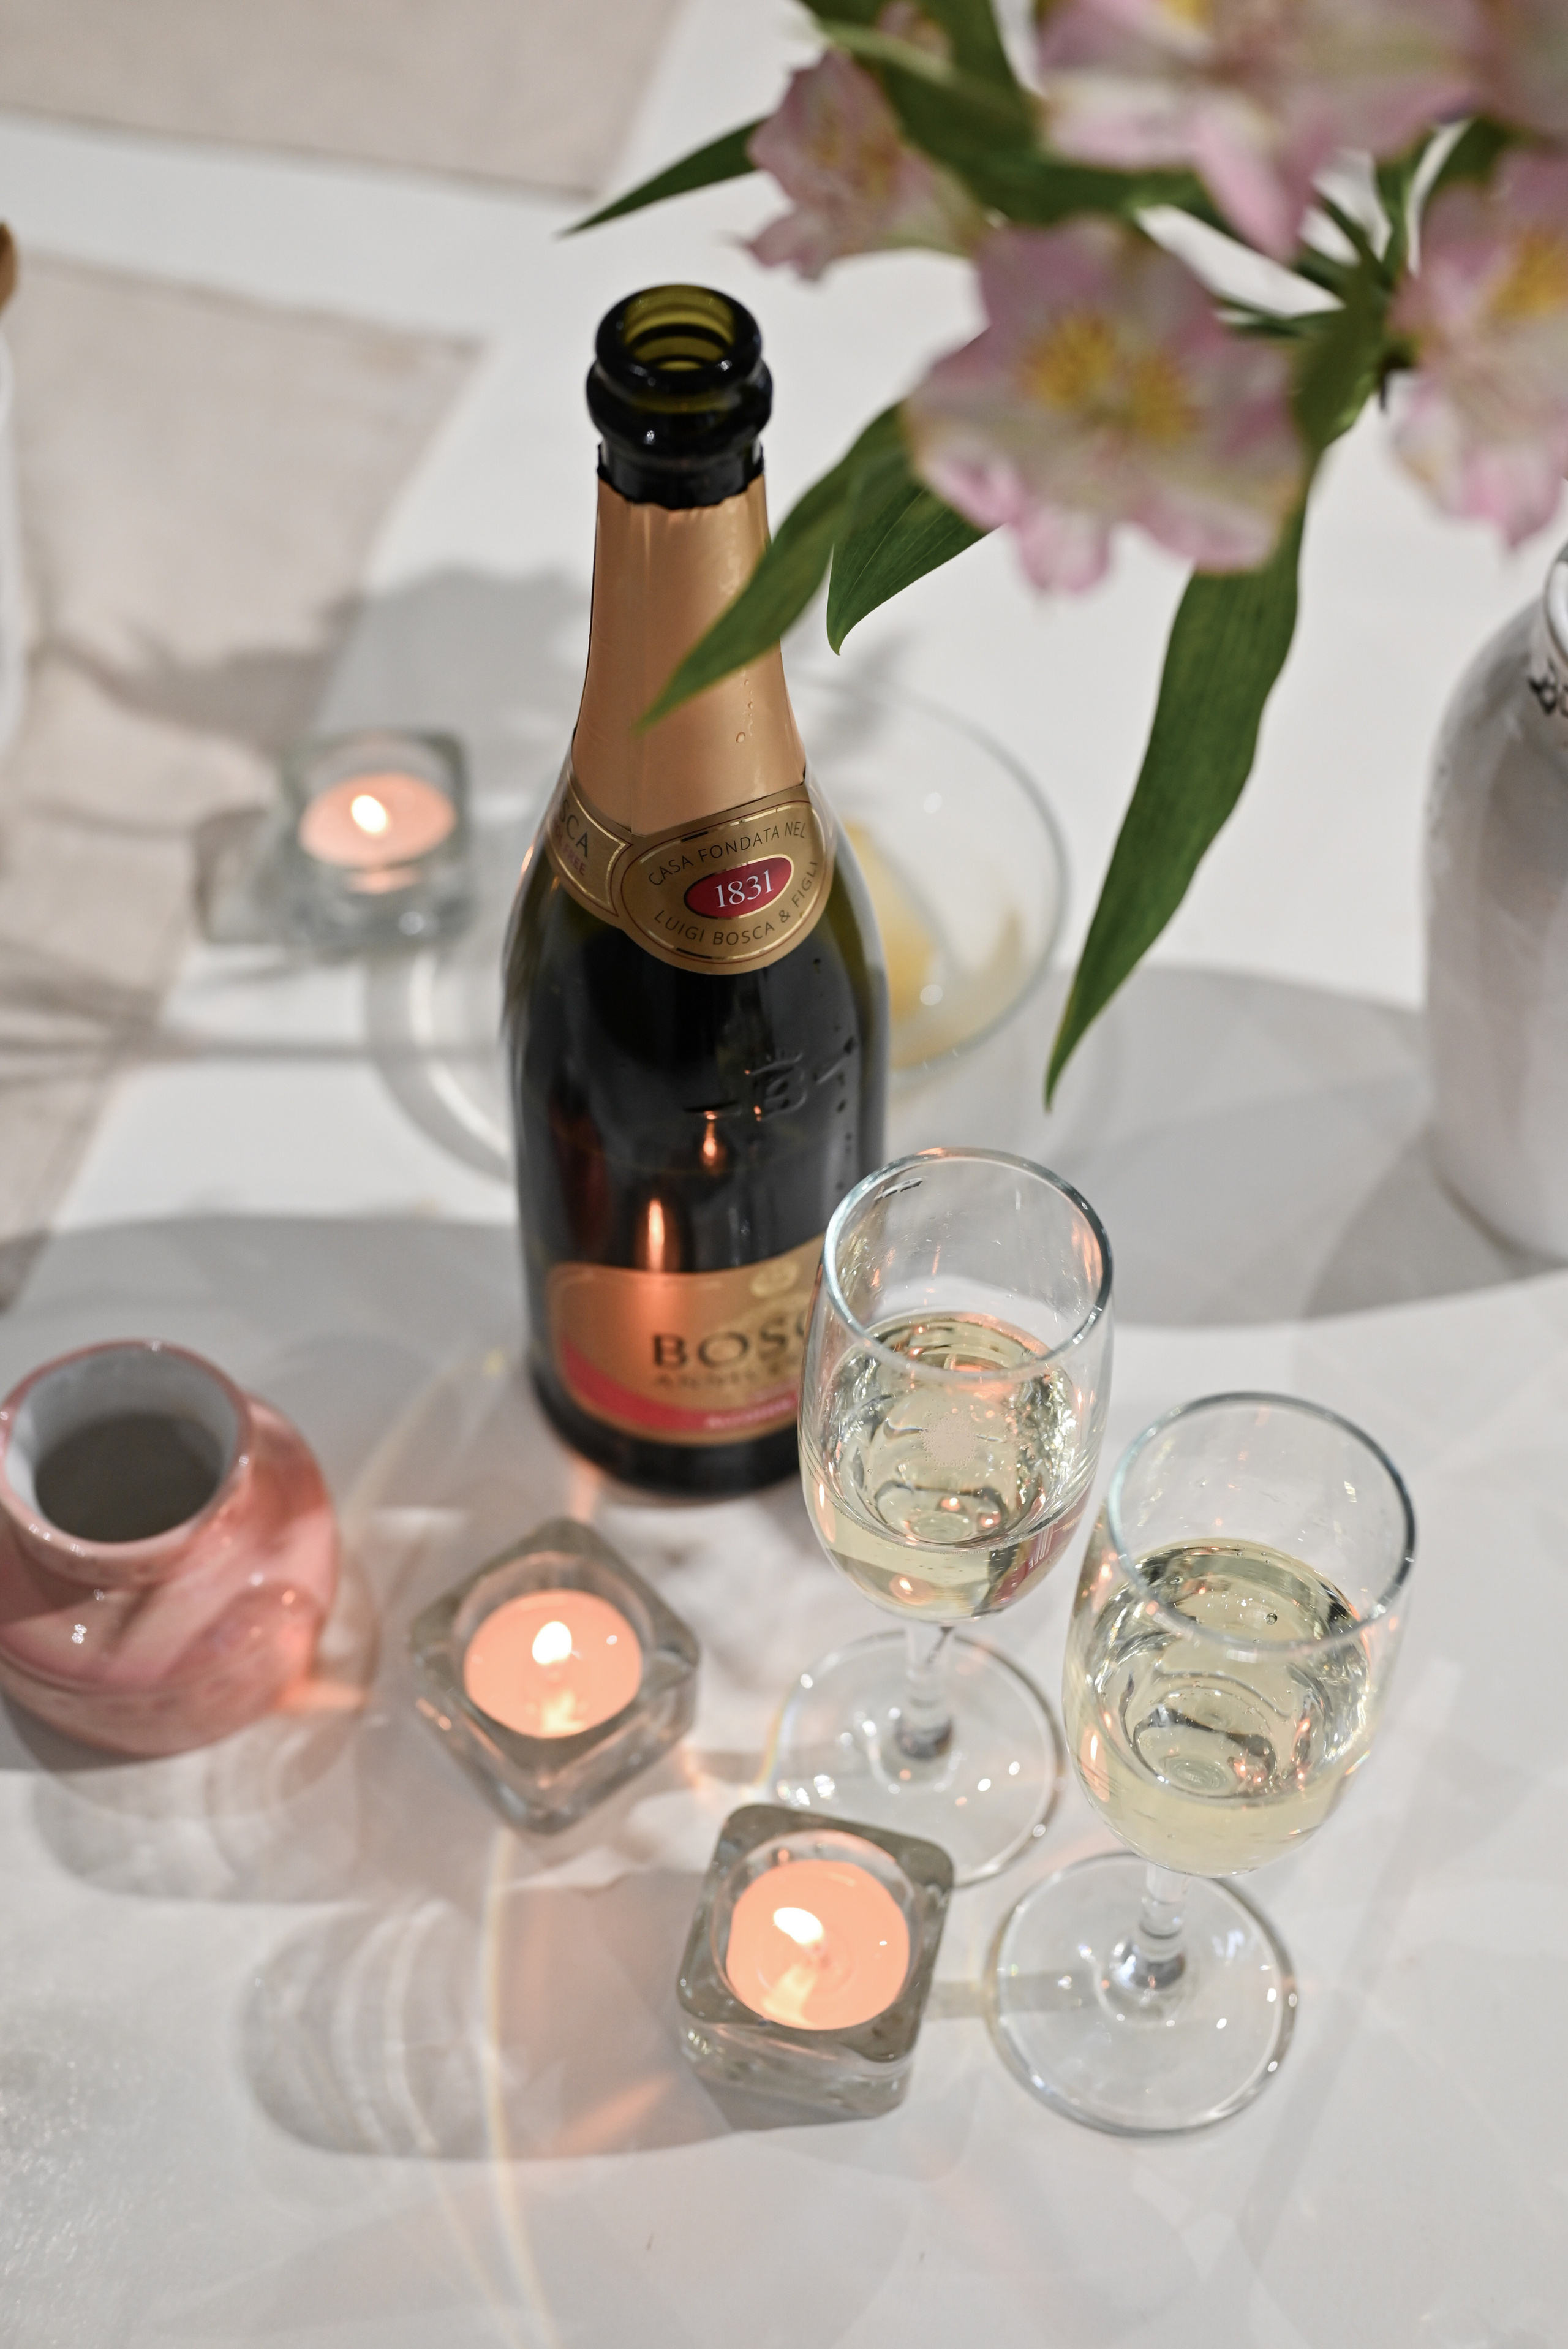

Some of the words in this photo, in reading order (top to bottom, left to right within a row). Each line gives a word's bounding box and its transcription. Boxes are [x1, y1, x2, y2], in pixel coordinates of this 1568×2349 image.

[563, 843, 586, 876] FREE
[649, 855, 693, 885] CASA
[698, 826, 779, 862] FONDATA
[785, 821, 805, 839] NEL
[654, 910, 704, 942] LUIGI
[713, 922, 775, 945] BOSCA
[778, 910, 790, 923] &
[792, 861, 817, 907] FIGLI
[714, 869, 774, 907] 1831
